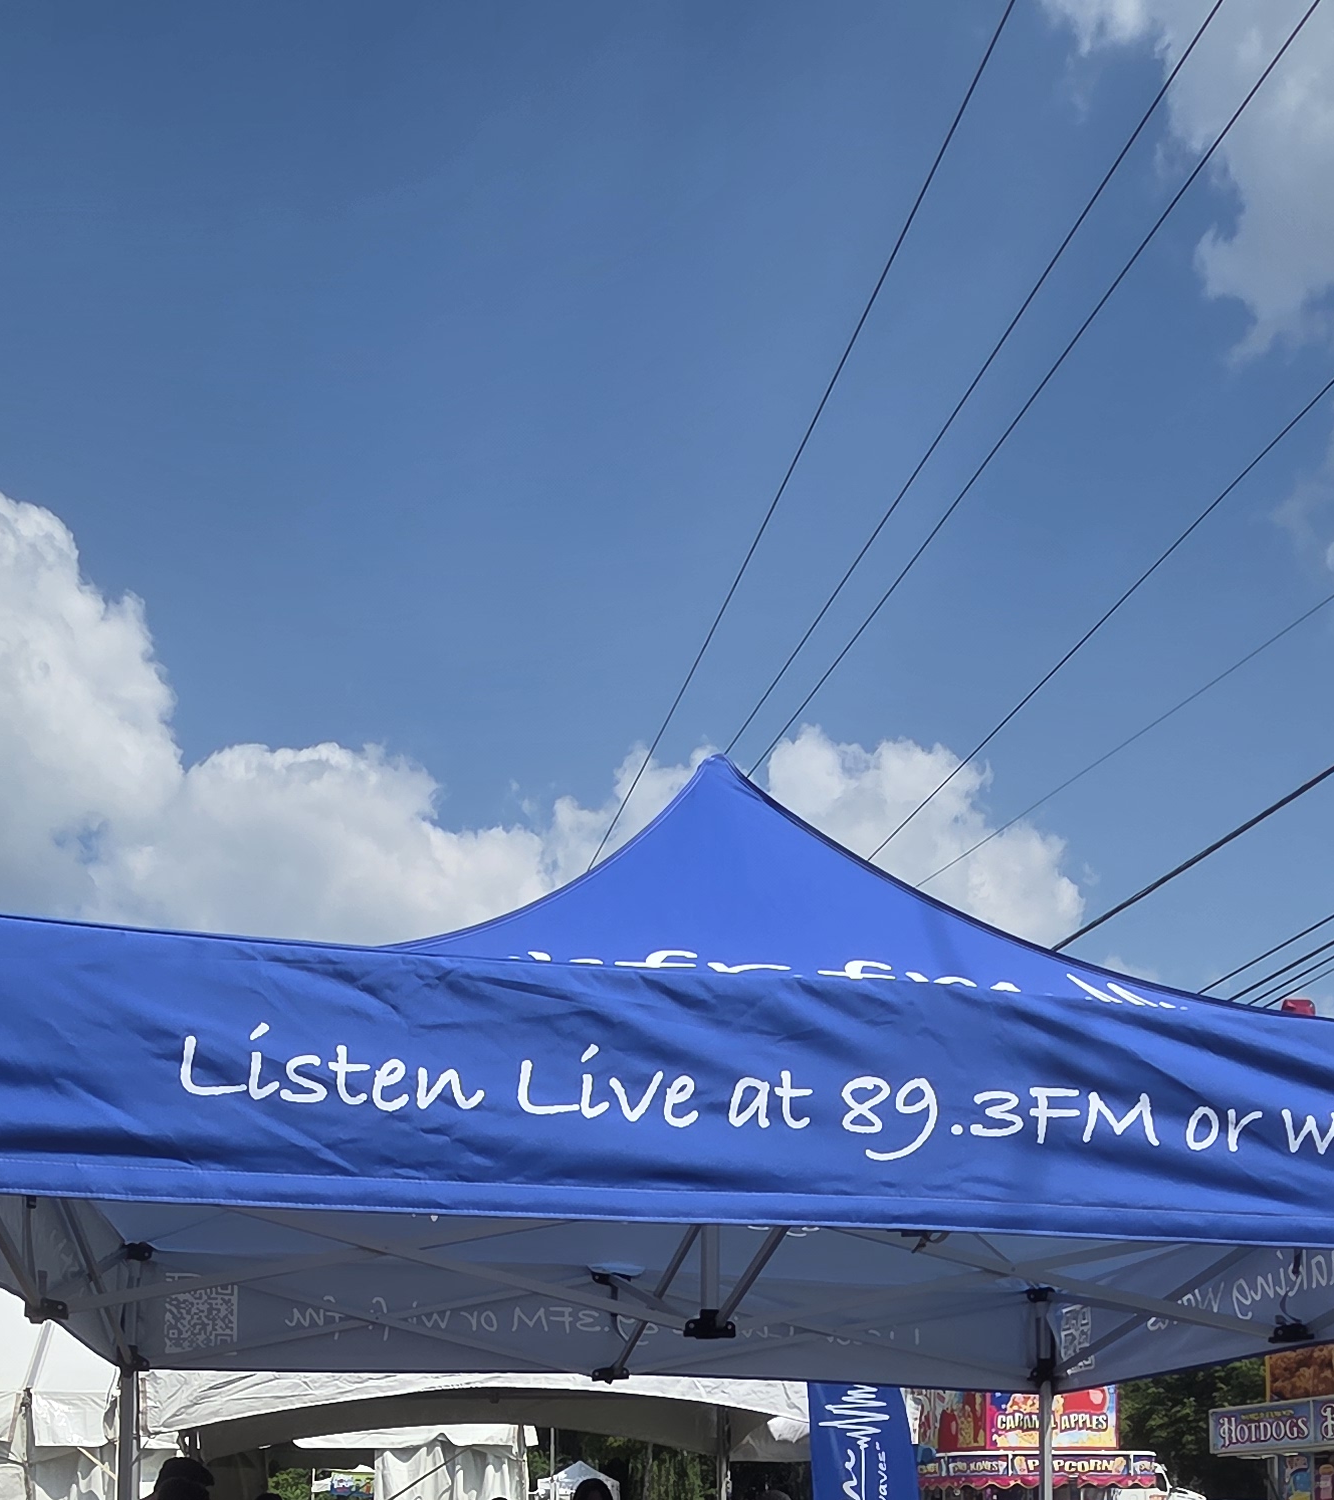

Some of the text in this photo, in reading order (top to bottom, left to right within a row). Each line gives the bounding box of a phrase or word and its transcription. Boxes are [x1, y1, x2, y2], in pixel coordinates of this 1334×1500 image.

[180, 1022, 484, 1112] Listen
[518, 1044, 699, 1128] Live
[728, 1070, 814, 1130] at
[840, 1075, 1160, 1161] 89.3FM
[1185, 1105, 1263, 1153] or
[998, 1413, 1107, 1431] CARAML APPLES
[1219, 1415, 1309, 1449] HOTDOGS
[1027, 1458, 1114, 1473] PPCORN
